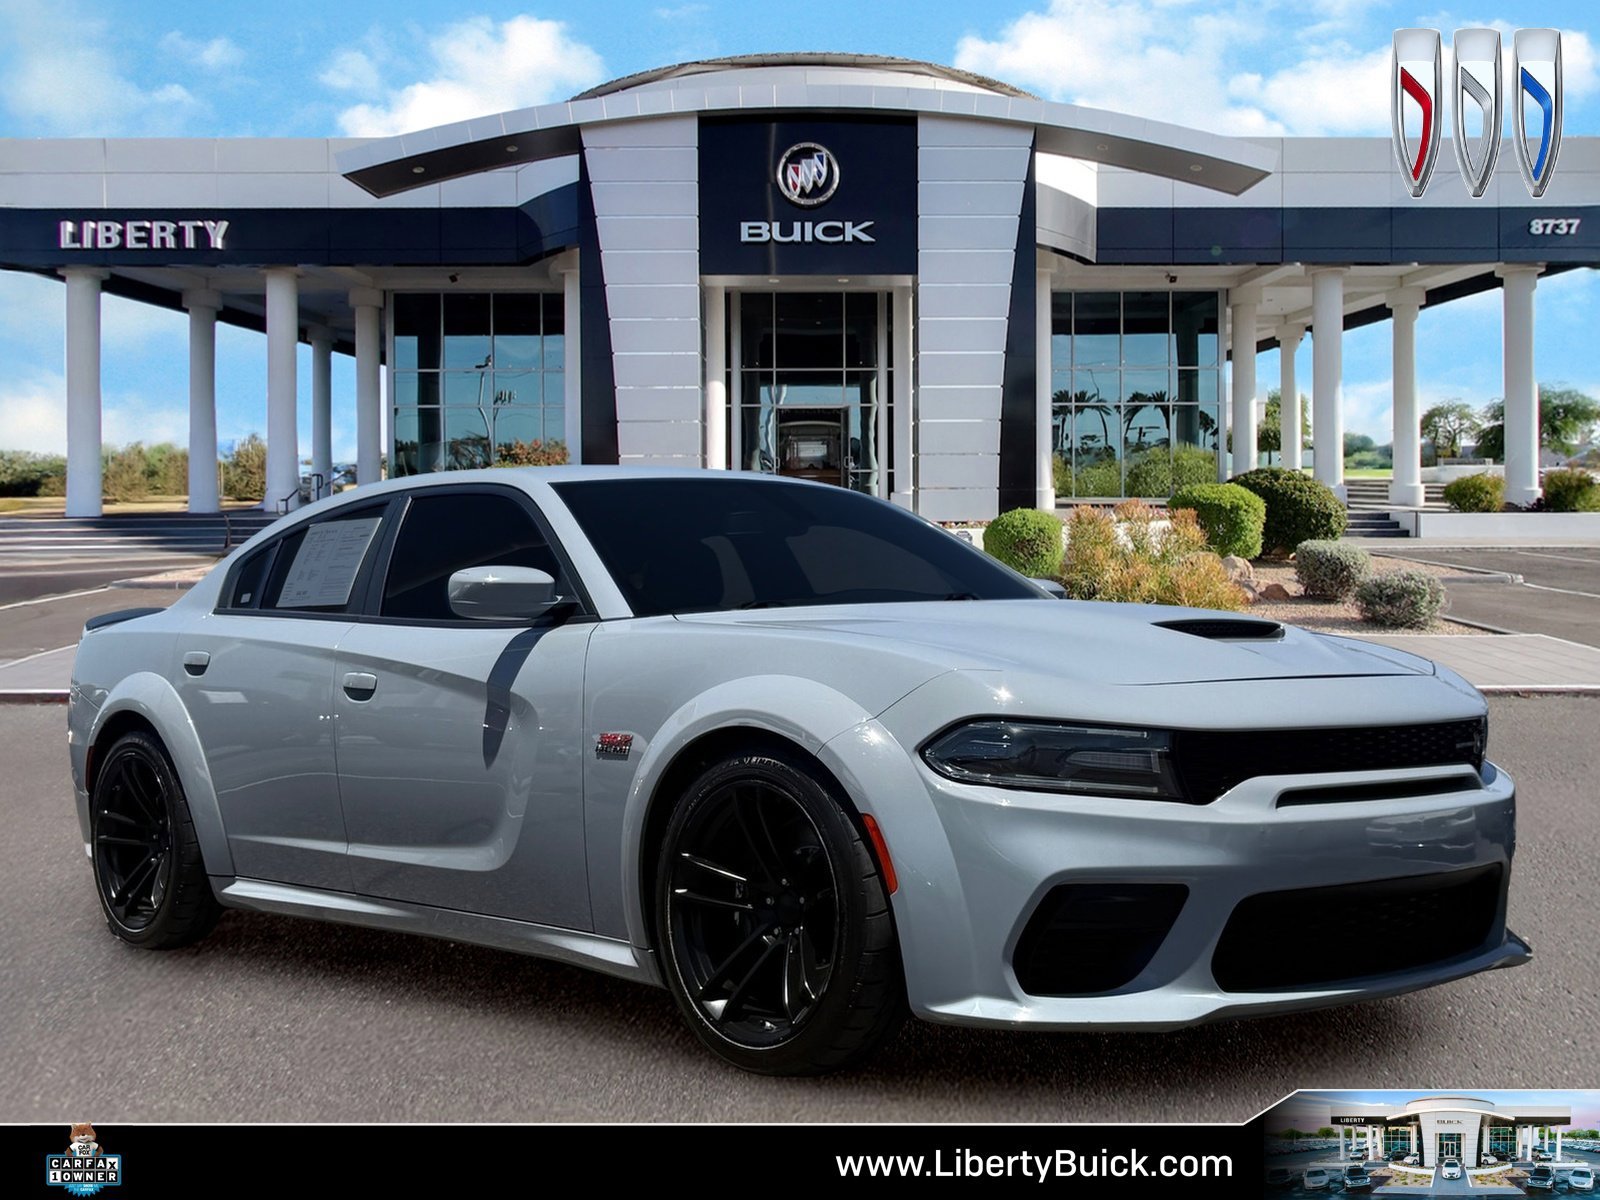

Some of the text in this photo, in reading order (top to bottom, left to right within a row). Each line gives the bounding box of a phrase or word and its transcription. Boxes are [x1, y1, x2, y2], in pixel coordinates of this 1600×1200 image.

[59, 219, 229, 249] LIBERTY
[740, 221, 876, 242] BUICK
[1529, 218, 1581, 235] 8737
